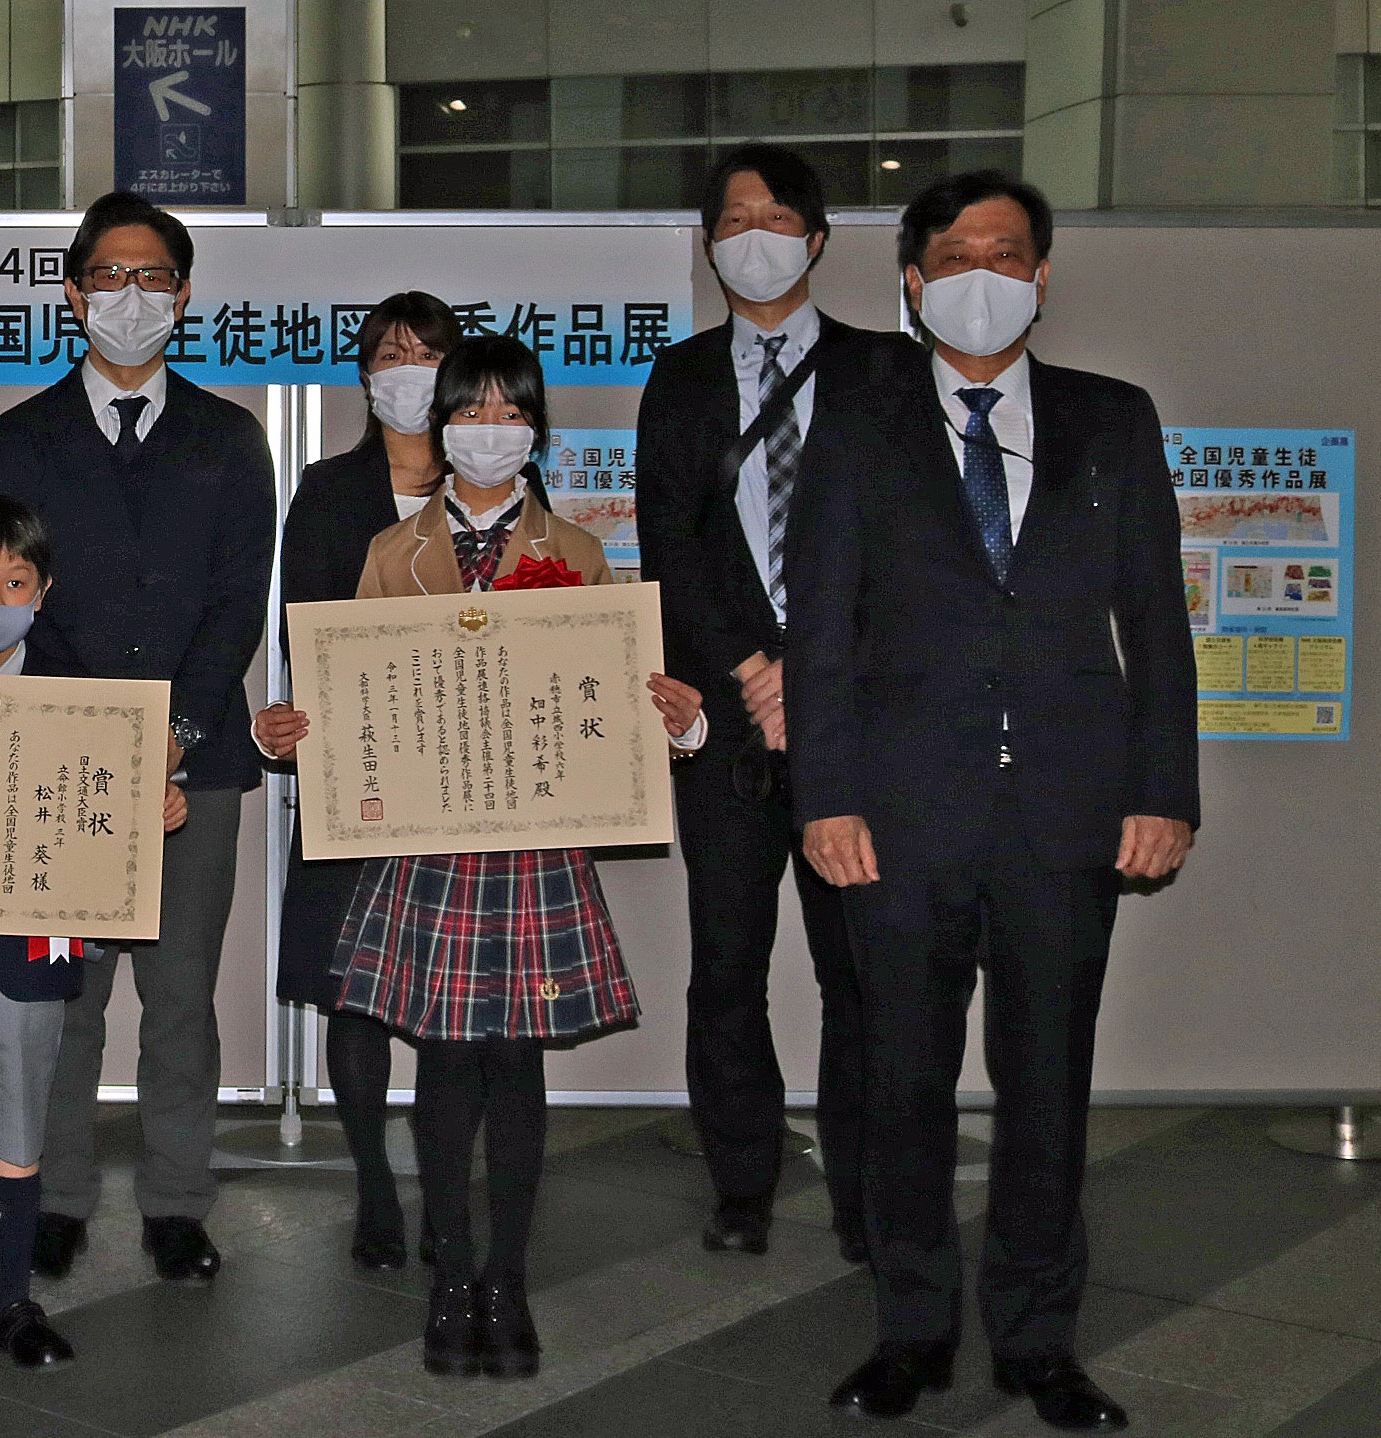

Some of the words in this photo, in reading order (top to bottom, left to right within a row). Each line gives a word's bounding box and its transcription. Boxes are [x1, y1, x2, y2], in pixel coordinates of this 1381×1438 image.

[143, 16, 218, 36] NHK
[123, 39, 237, 68] 大阪ホール
[138, 169, 222, 180] エスカレーターで
[559, 447, 637, 467] 全国児
[1179, 446, 1318, 467] 全国児童生徒
[578, 676, 606, 740] 賞状
[76, 756, 91, 833] 国土交通大臣賞
[87, 767, 115, 837] 賞状
[1, 730, 21, 895] あなたの作品は全国児童生徒地図
